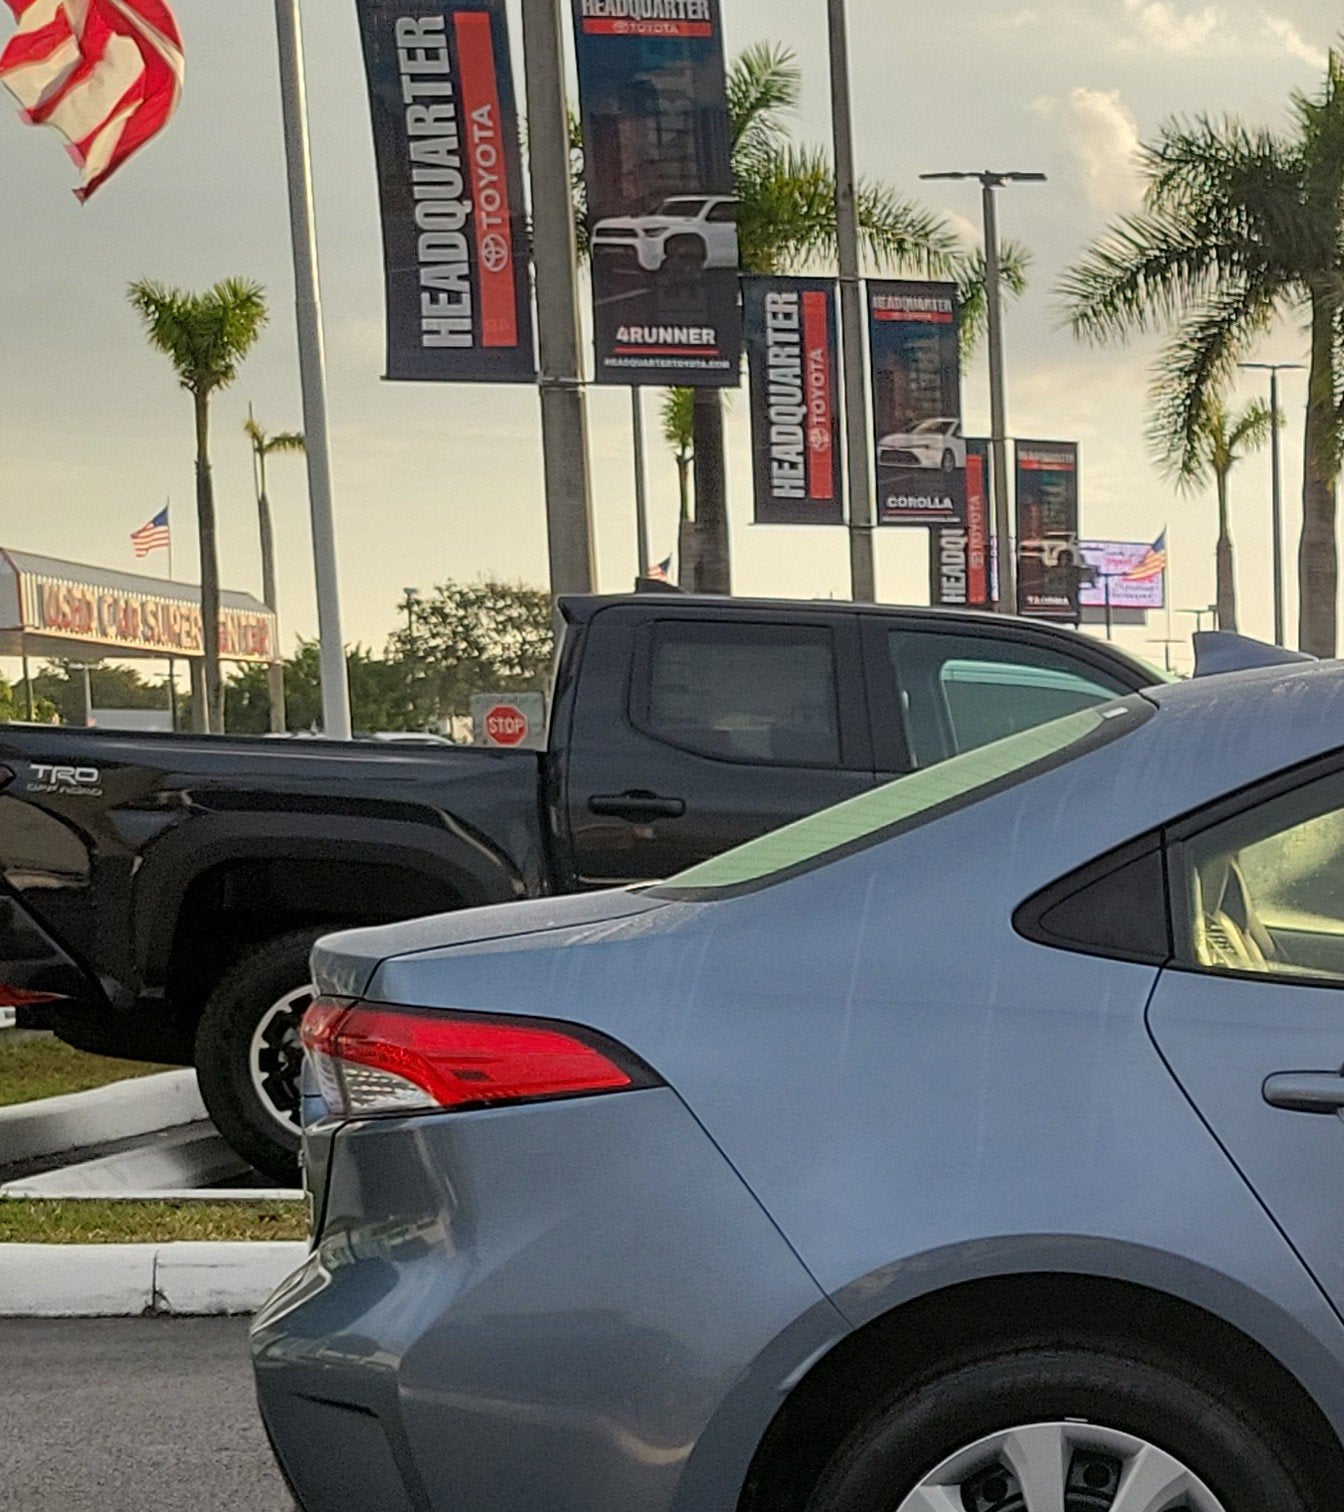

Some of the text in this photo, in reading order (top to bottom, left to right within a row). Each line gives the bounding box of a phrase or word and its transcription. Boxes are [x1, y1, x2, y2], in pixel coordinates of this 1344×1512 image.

[630, 23, 678, 34] TOYOTA
[471, 104, 505, 230] TOYOTA
[395, 14, 473, 348] HEADQUARTER
[615, 326, 716, 345] 4RUNNER
[766, 291, 807, 498] HEADQUARTER
[809, 349, 829, 425] TOYOTA
[886, 496, 953, 509] COROLLA
[488, 716, 525, 735] STOP
[30, 764, 99, 785] TRD
